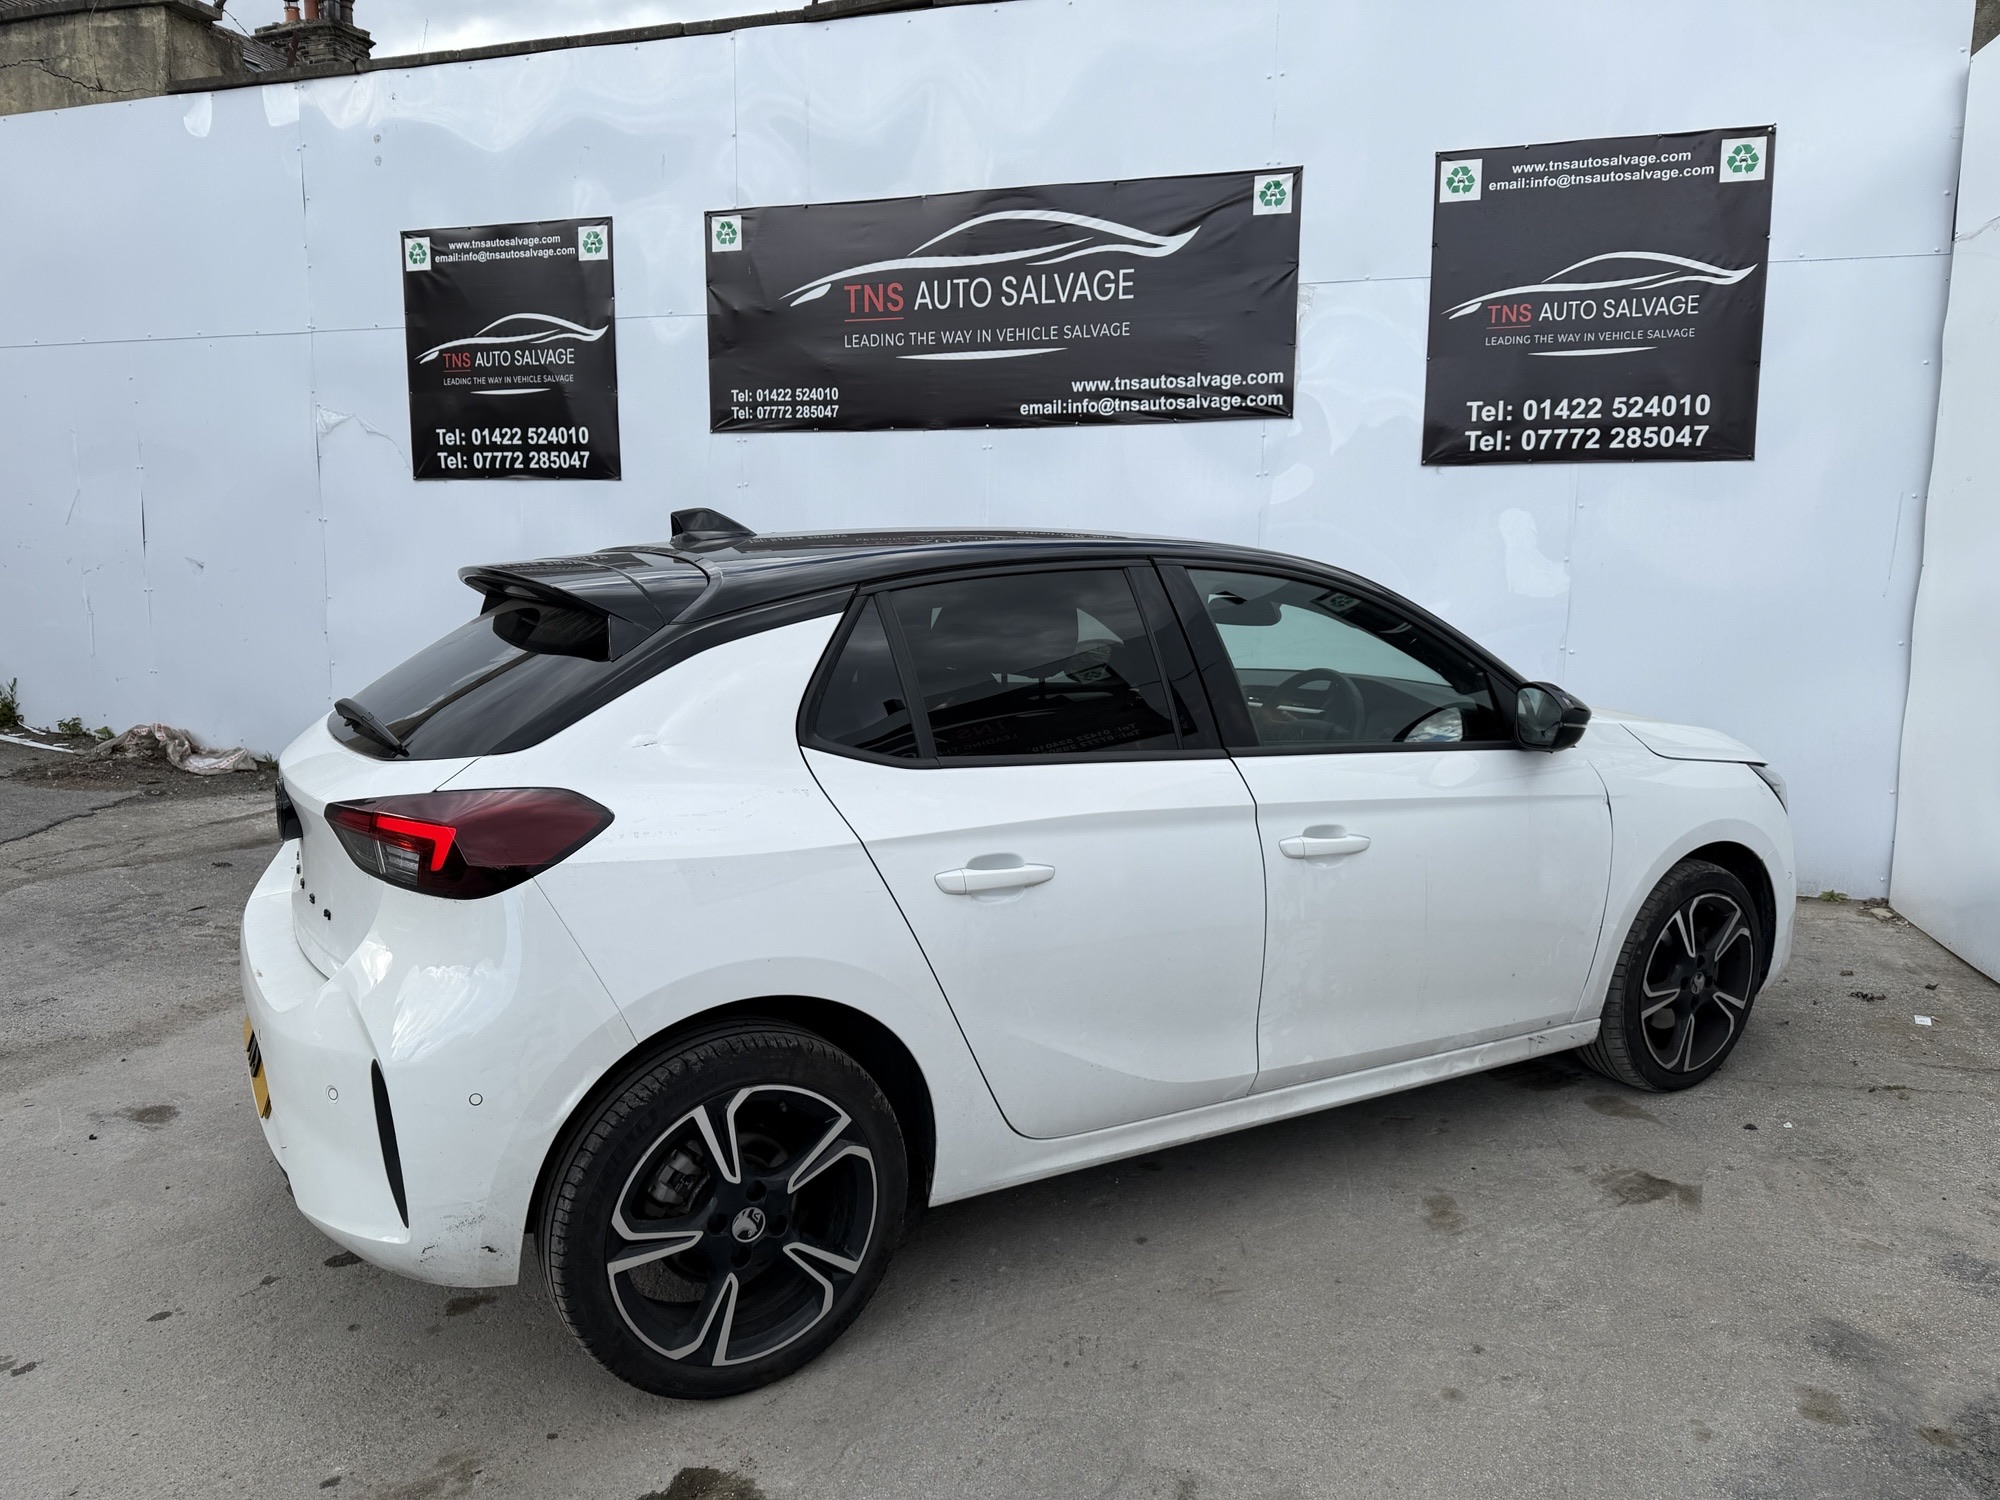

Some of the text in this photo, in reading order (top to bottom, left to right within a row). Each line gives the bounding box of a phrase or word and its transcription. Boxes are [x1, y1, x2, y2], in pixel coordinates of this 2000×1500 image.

[1512, 152, 1692, 174] www.tnsautosalvage.com
[1488, 165, 1715, 191] email:info@tnsautosalvage.com
[448, 236, 561, 250] www.tnsautosalvage.com
[435, 246, 576, 263] email:info@tnsautosalvage.com
[844, 268, 1135, 313] TNS AUTO SALVAGE
[1487, 295, 1700, 323] TNS AUTO SALVAGE
[844, 322, 1130, 348] LEADING THE WAY IN VEHICLE SALVAGE
[1485, 328, 1695, 346] LEADING THE WAY IN VEHICLE SALVAGE
[442, 348, 575, 368] TNS AUTO SALVAGE
[443, 377, 472, 386] LEADING
[473, 376, 486, 385] THE
[487, 376, 503, 384] WAY
[513, 375, 542, 383] VEHICLE
[543, 374, 574, 383] SALVAGE
[1071, 371, 1284, 393] www.tnsautosalvage.com
[731, 387, 839, 402] Tel: 01422 524010
[1020, 394, 1283, 416] email:info@tnsautosalvage.com
[731, 405, 839, 419] Tel: 07772 285047
[1466, 394, 1710, 422] Tel: 01422 524010
[436, 427, 589, 445] Tel: 01422 524010
[1465, 425, 1709, 451] Tel: 07772 285047
[437, 451, 590, 469] Tel: 07772 285047
